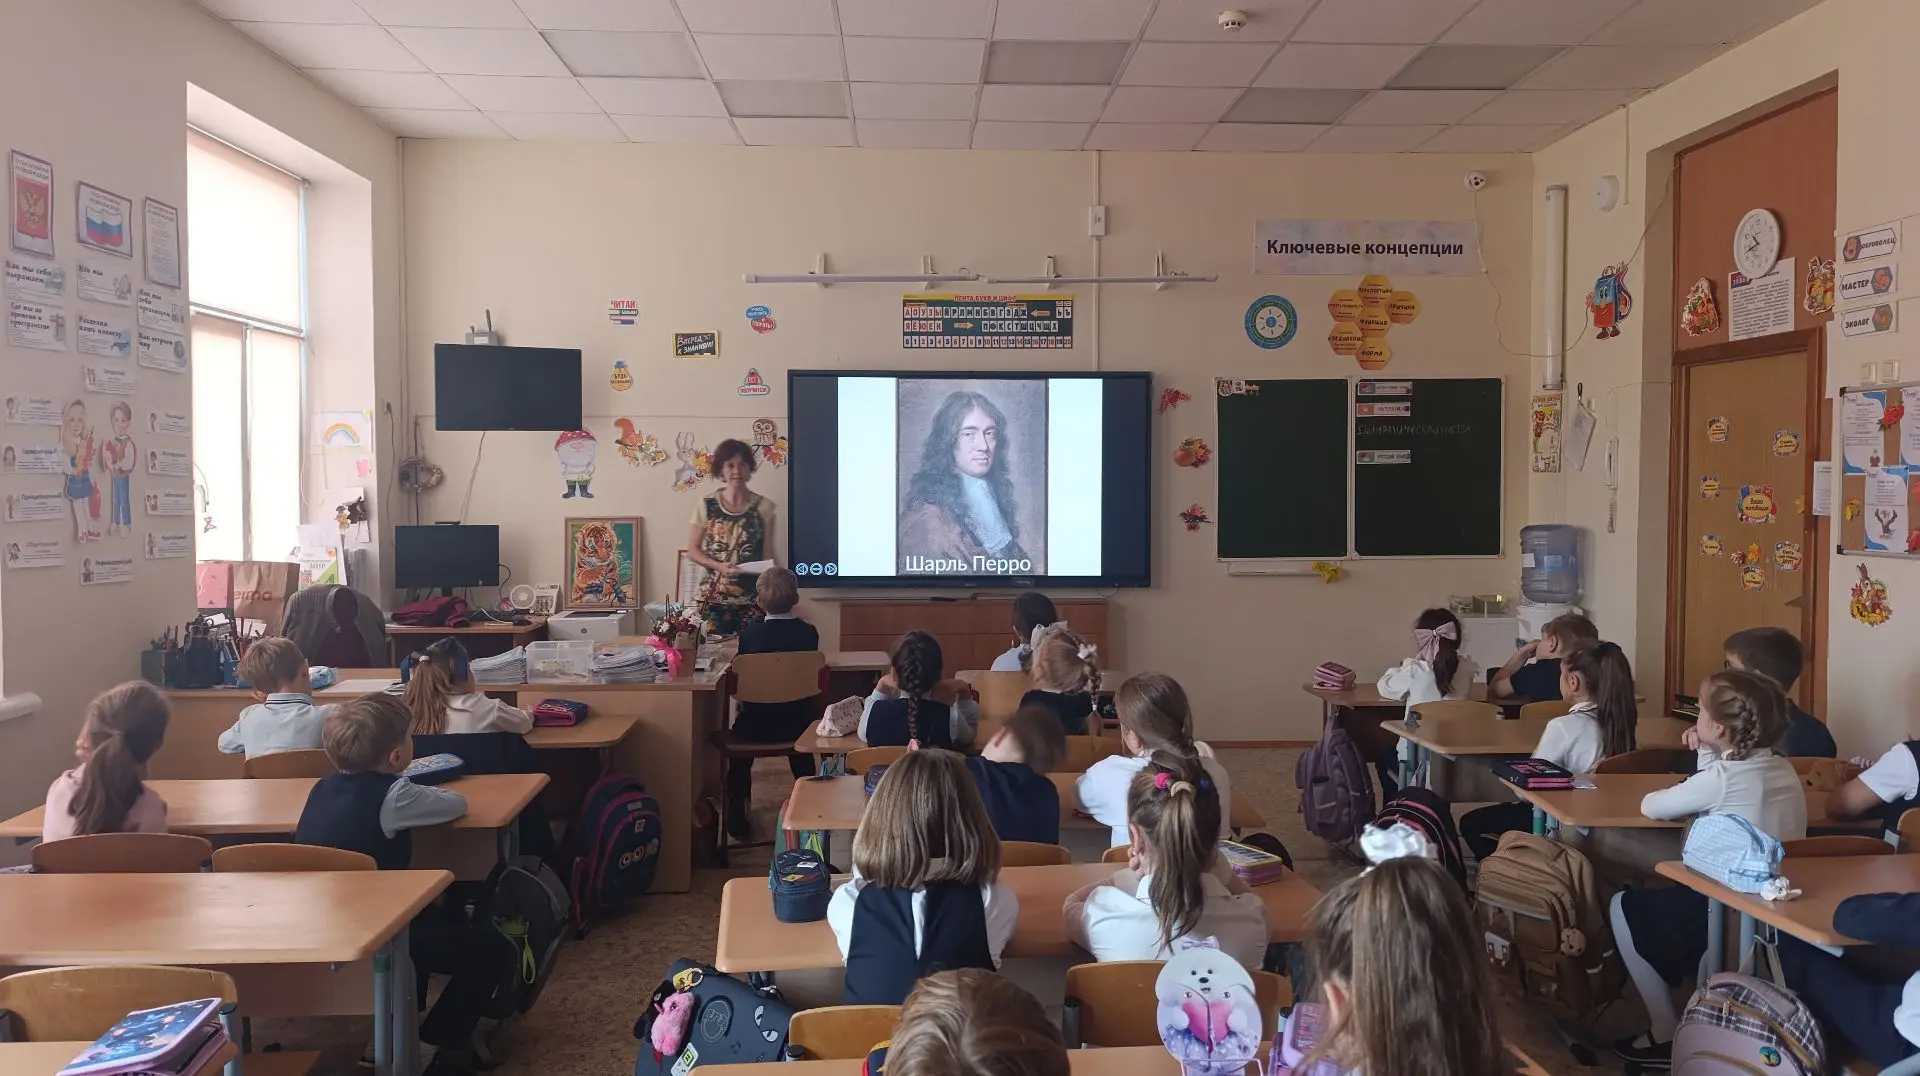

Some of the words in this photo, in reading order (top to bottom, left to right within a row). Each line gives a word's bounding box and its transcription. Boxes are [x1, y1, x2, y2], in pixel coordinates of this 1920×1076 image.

[1267, 239, 1360, 255] Ключевые
[1365, 240, 1463, 257] концепции
[1861, 238, 1896, 249] ОБРОВОЛЕЦ
[1841, 280, 1869, 291] МАСТЕР
[1845, 318, 1869, 329] ЭКОЛОГ
[905, 556, 967, 574] Шарль
[973, 556, 1031, 574] Перро
[234, 591, 273, 601] eima
